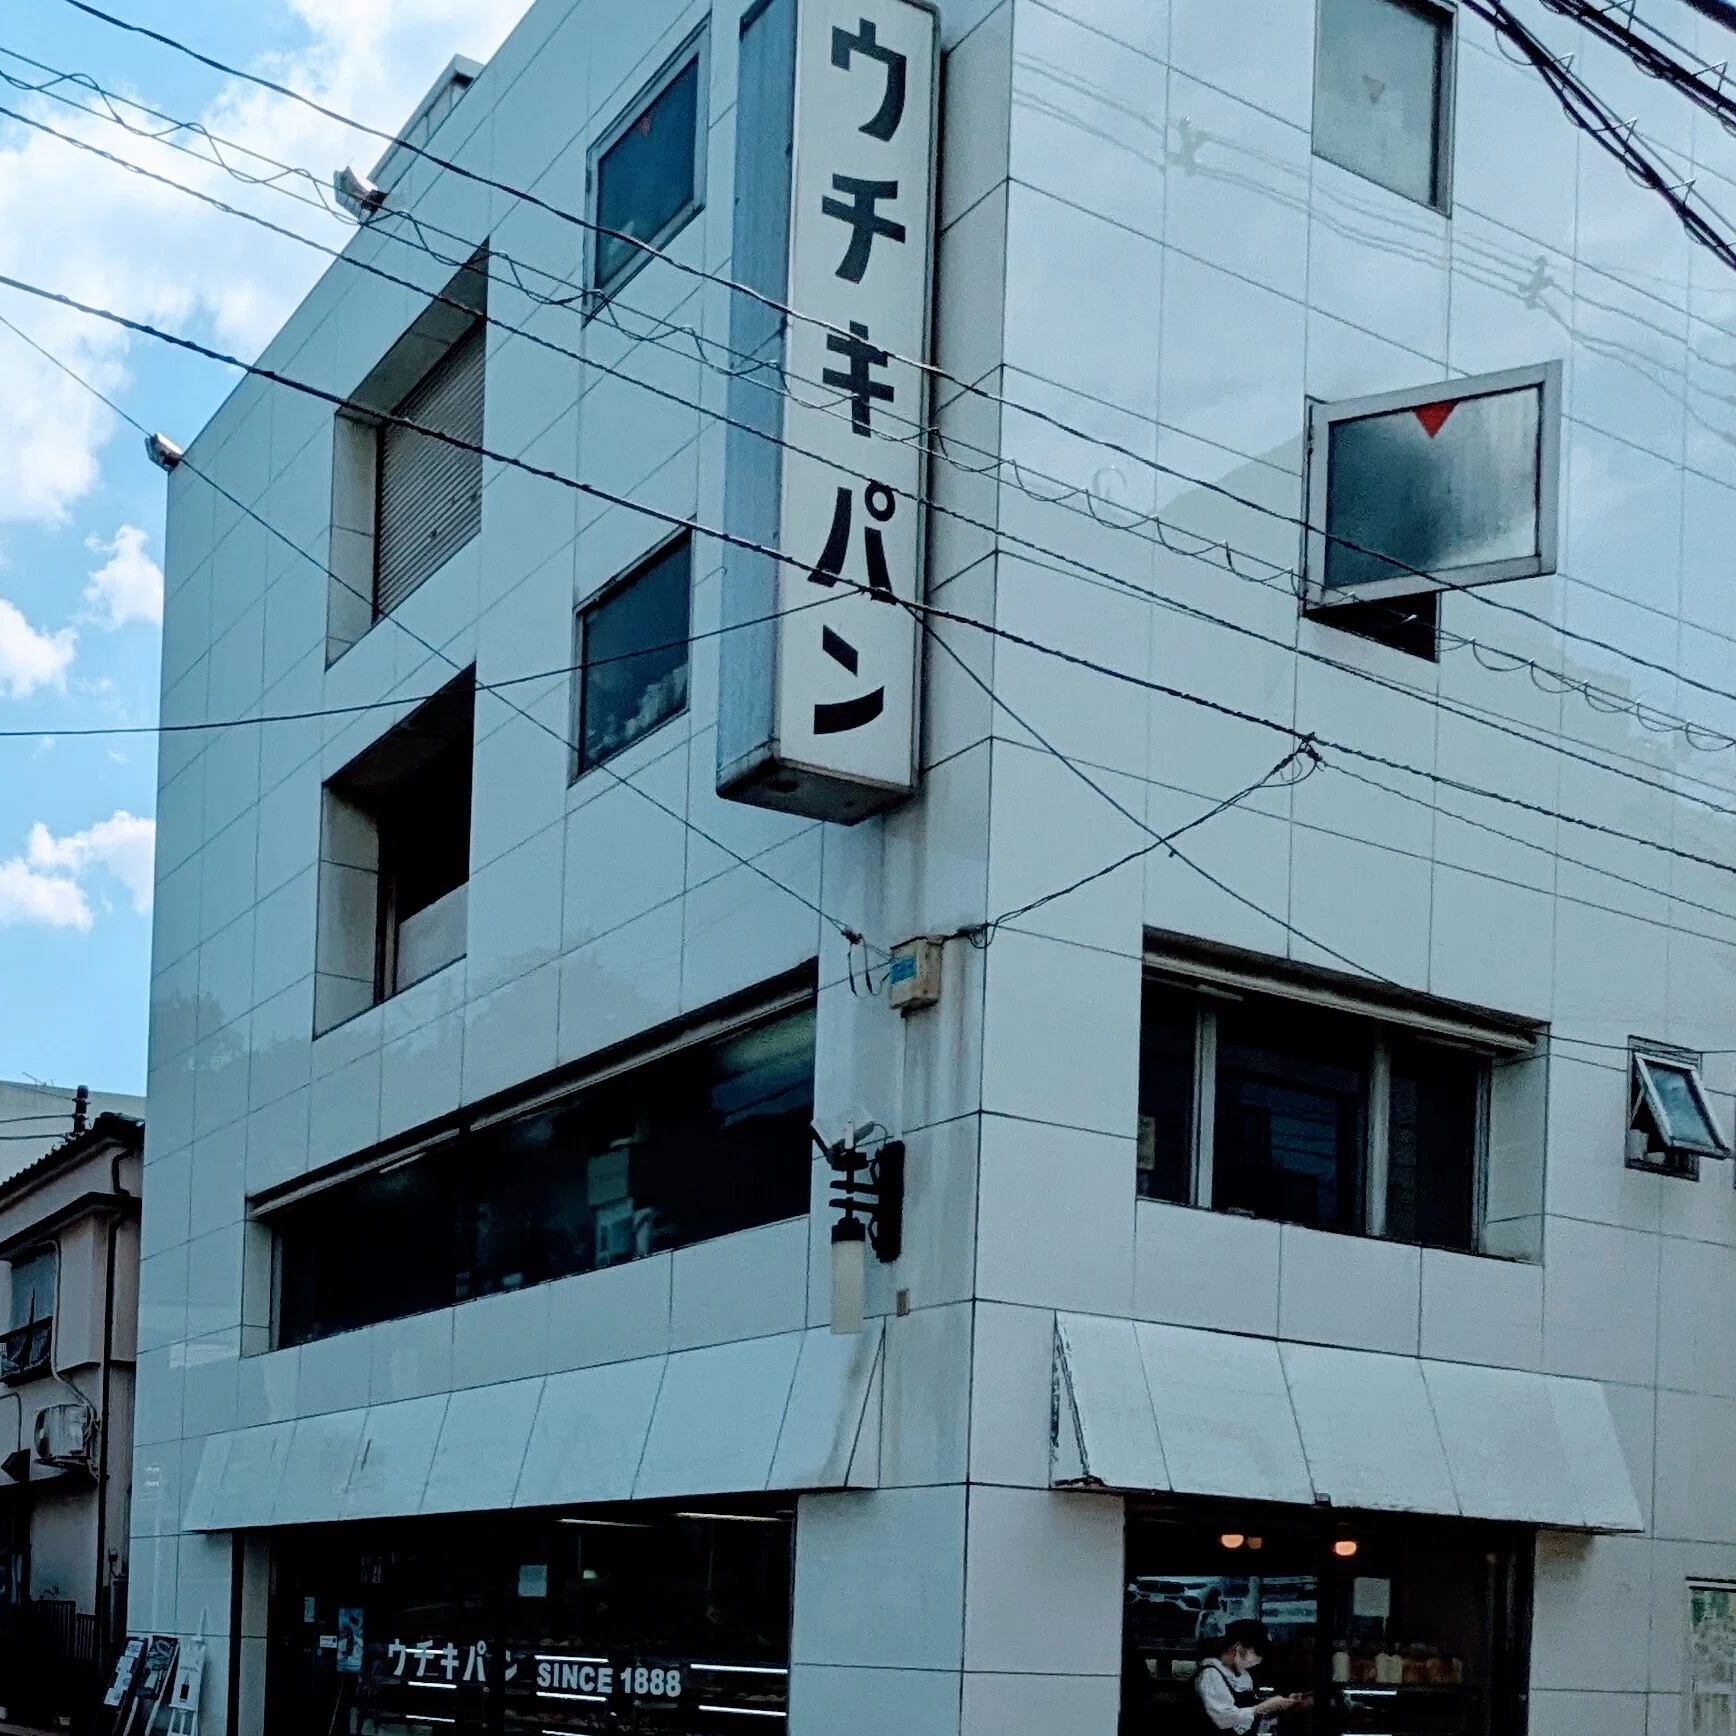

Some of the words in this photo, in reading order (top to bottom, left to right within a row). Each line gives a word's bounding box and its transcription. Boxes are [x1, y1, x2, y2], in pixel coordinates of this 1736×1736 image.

[807, 17, 907, 736] ウチキパン
[536, 1661, 614, 1694] SINCE
[620, 1666, 682, 1698] 1888
